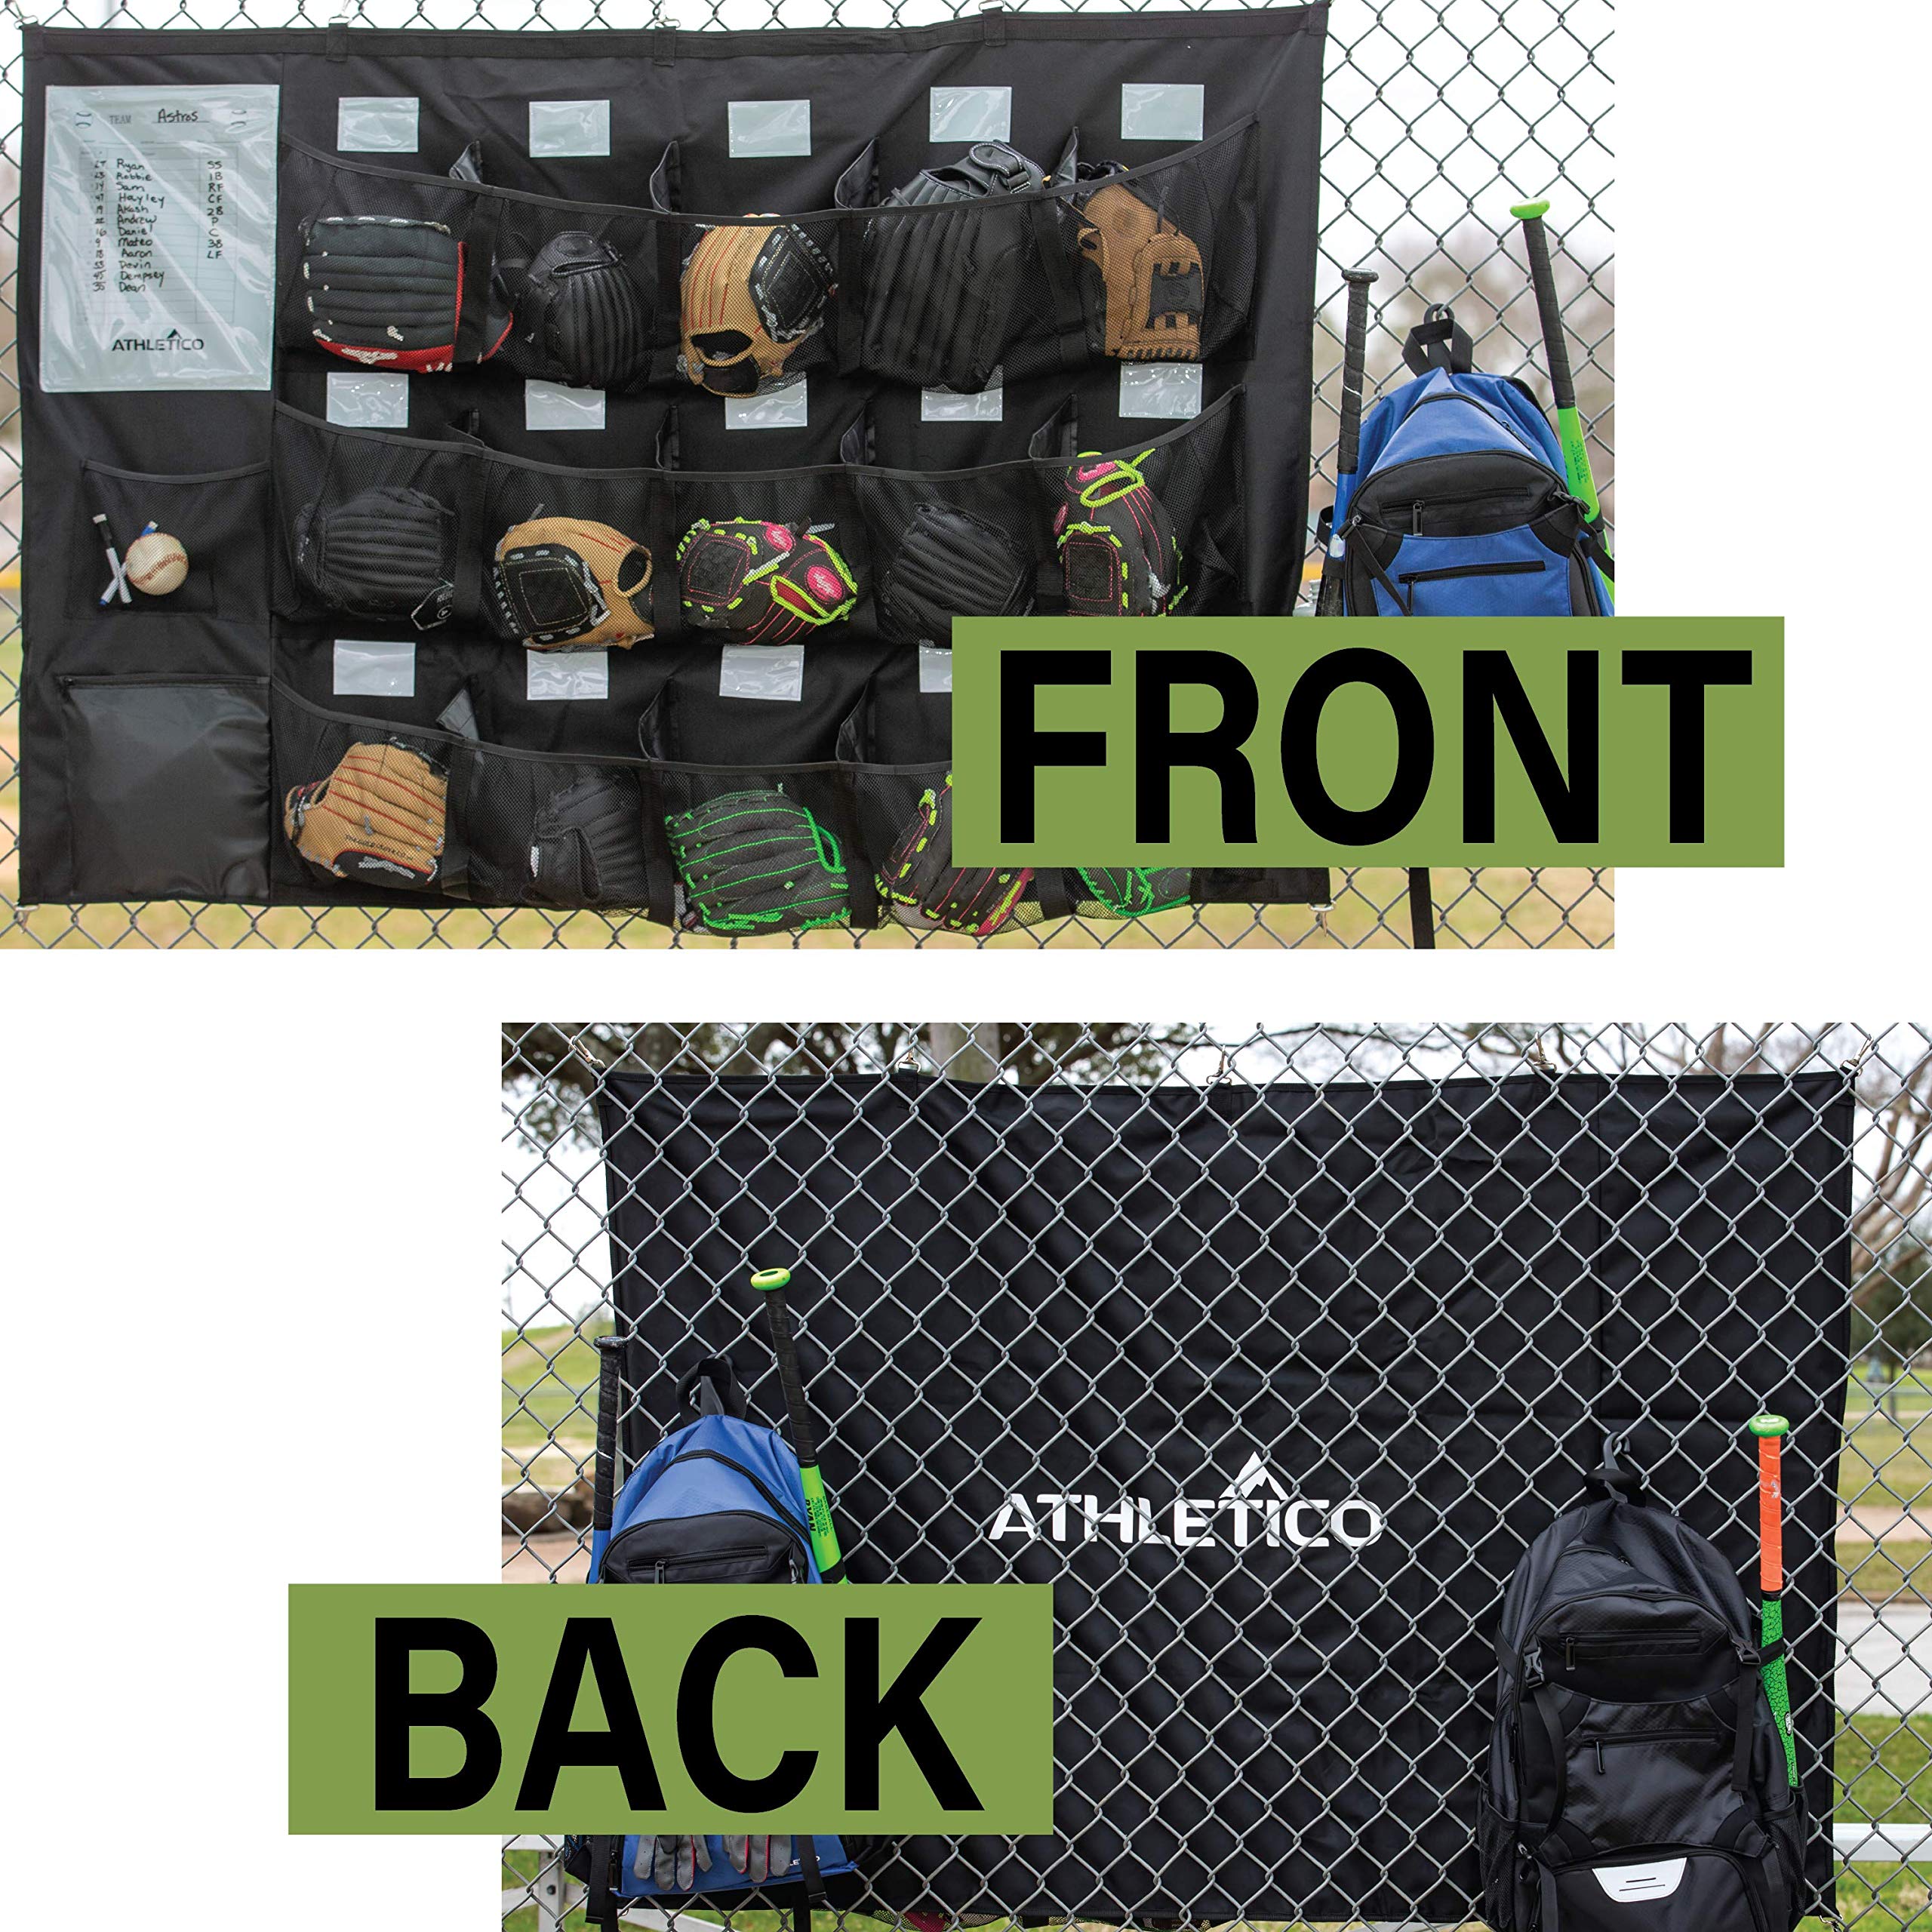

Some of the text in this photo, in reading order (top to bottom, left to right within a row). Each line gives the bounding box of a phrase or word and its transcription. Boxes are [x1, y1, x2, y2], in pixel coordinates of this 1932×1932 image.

[109, 115, 131, 125] TEAM
[157, 108, 199, 123] Astros
[116, 158, 146, 173] Ryan
[115, 172, 152, 181] Robbie
[115, 181, 145, 192] Sam
[208, 182, 223, 192] RF
[118, 192, 165, 209] Hayley
[208, 193, 223, 203] CF
[117, 214, 157, 226] Andrew
[211, 217, 219, 226] P
[117, 223, 152, 236] Daniel
[208, 228, 220, 237] C
[95, 238, 101, 248] 9
[118, 237, 153, 248] Mateo
[122, 248, 152, 258] Aaron
[207, 250, 223, 260] LF
[118, 259, 151, 269] Devin
[119, 270, 165, 288] Dempsey
[118, 281, 146, 293] Dean
[112, 338, 205, 351] ATHLETICO
[989, 1493, 1383, 1547] ATHLETICO
